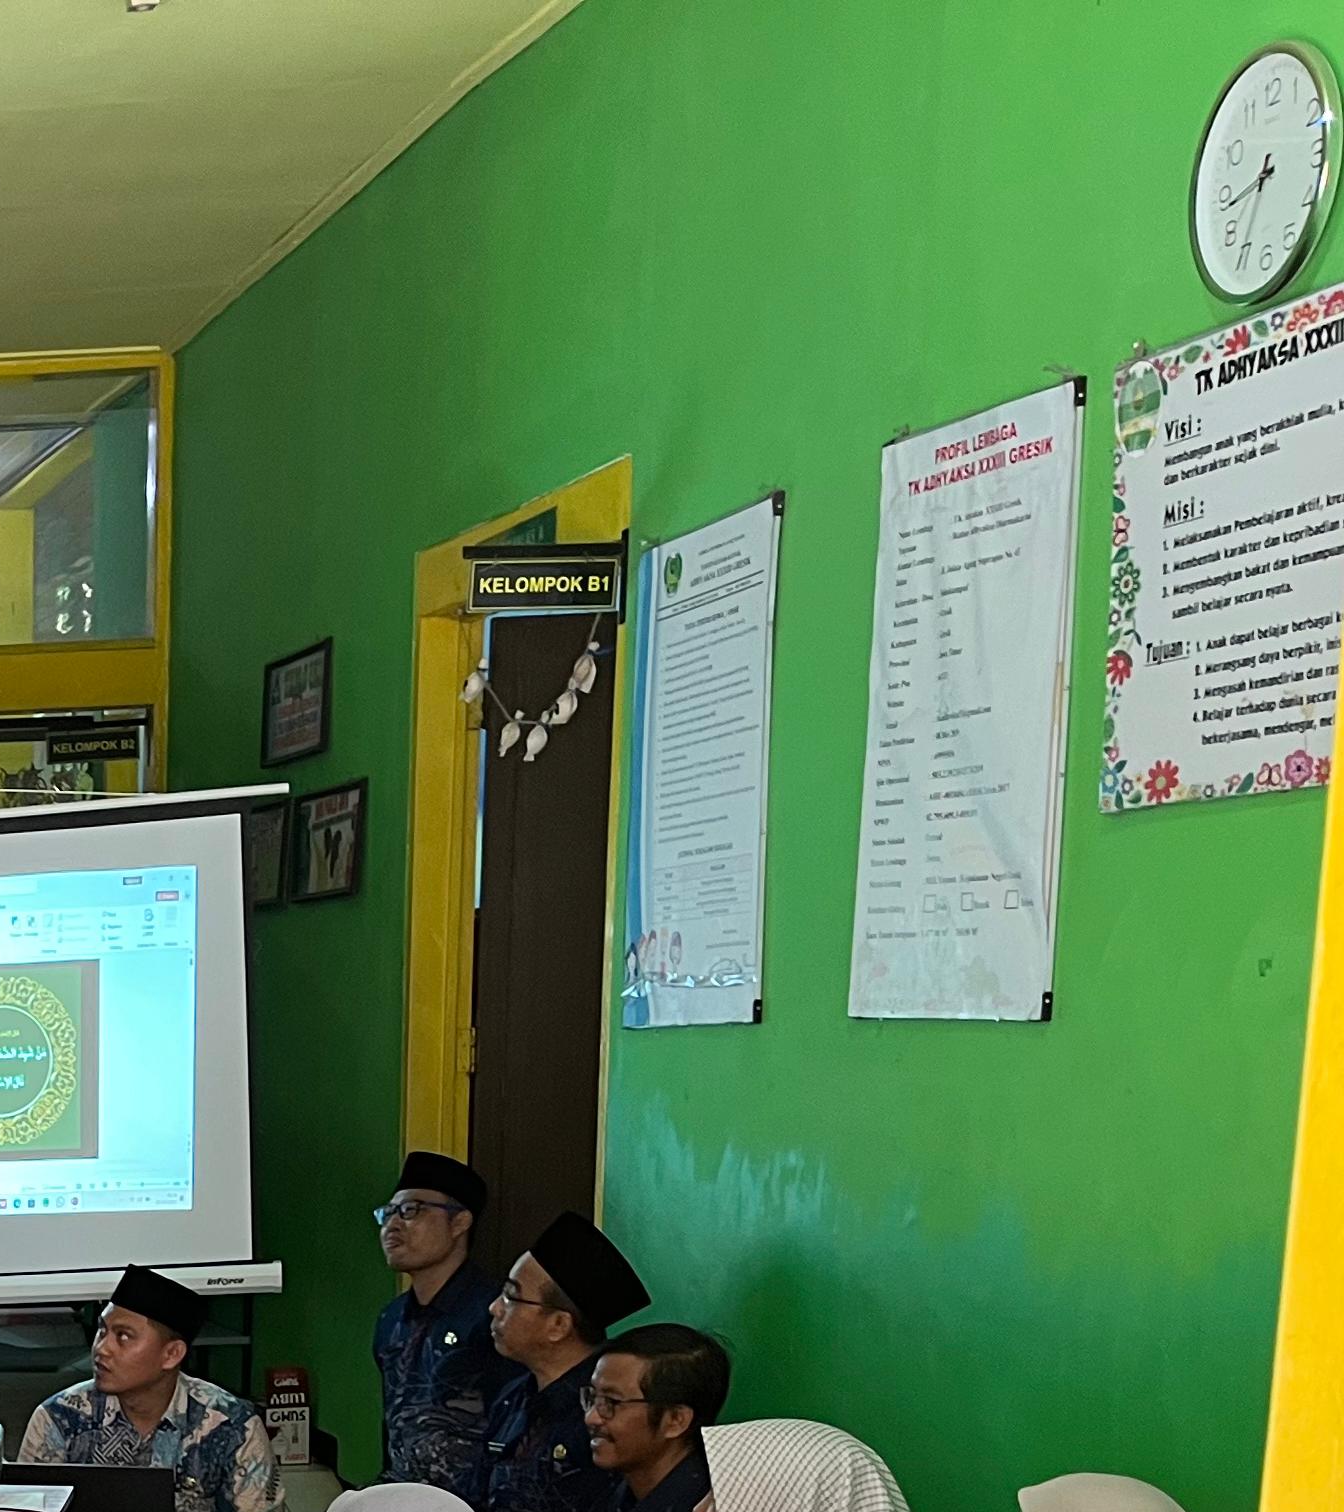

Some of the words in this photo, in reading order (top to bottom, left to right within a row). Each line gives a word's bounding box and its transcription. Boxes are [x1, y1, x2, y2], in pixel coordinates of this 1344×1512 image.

[1265, 77, 1281, 107] 12
[1306, 98, 1324, 127] 2
[1226, 139, 1243, 170] 10
[1225, 220, 1237, 247] 8
[1283, 223, 1296, 250] 5
[1260, 244, 1273, 271] 6
[1195, 367, 1214, 395] TK
[1217, 335, 1299, 388] ADHYAKSA
[1164, 414, 1192, 442] Visi
[934, 439, 969, 465] PROFIL
[973, 422, 1018, 452] LEMBAGA
[1009, 436, 1054, 464] GRESIK
[1163, 496, 1195, 525] Misi
[479, 576, 583, 594] KELOMPOK
[588, 575, 610, 592] B1
[53, 740, 119, 754] KELOMPOK
[120, 739, 136, 750] B2
